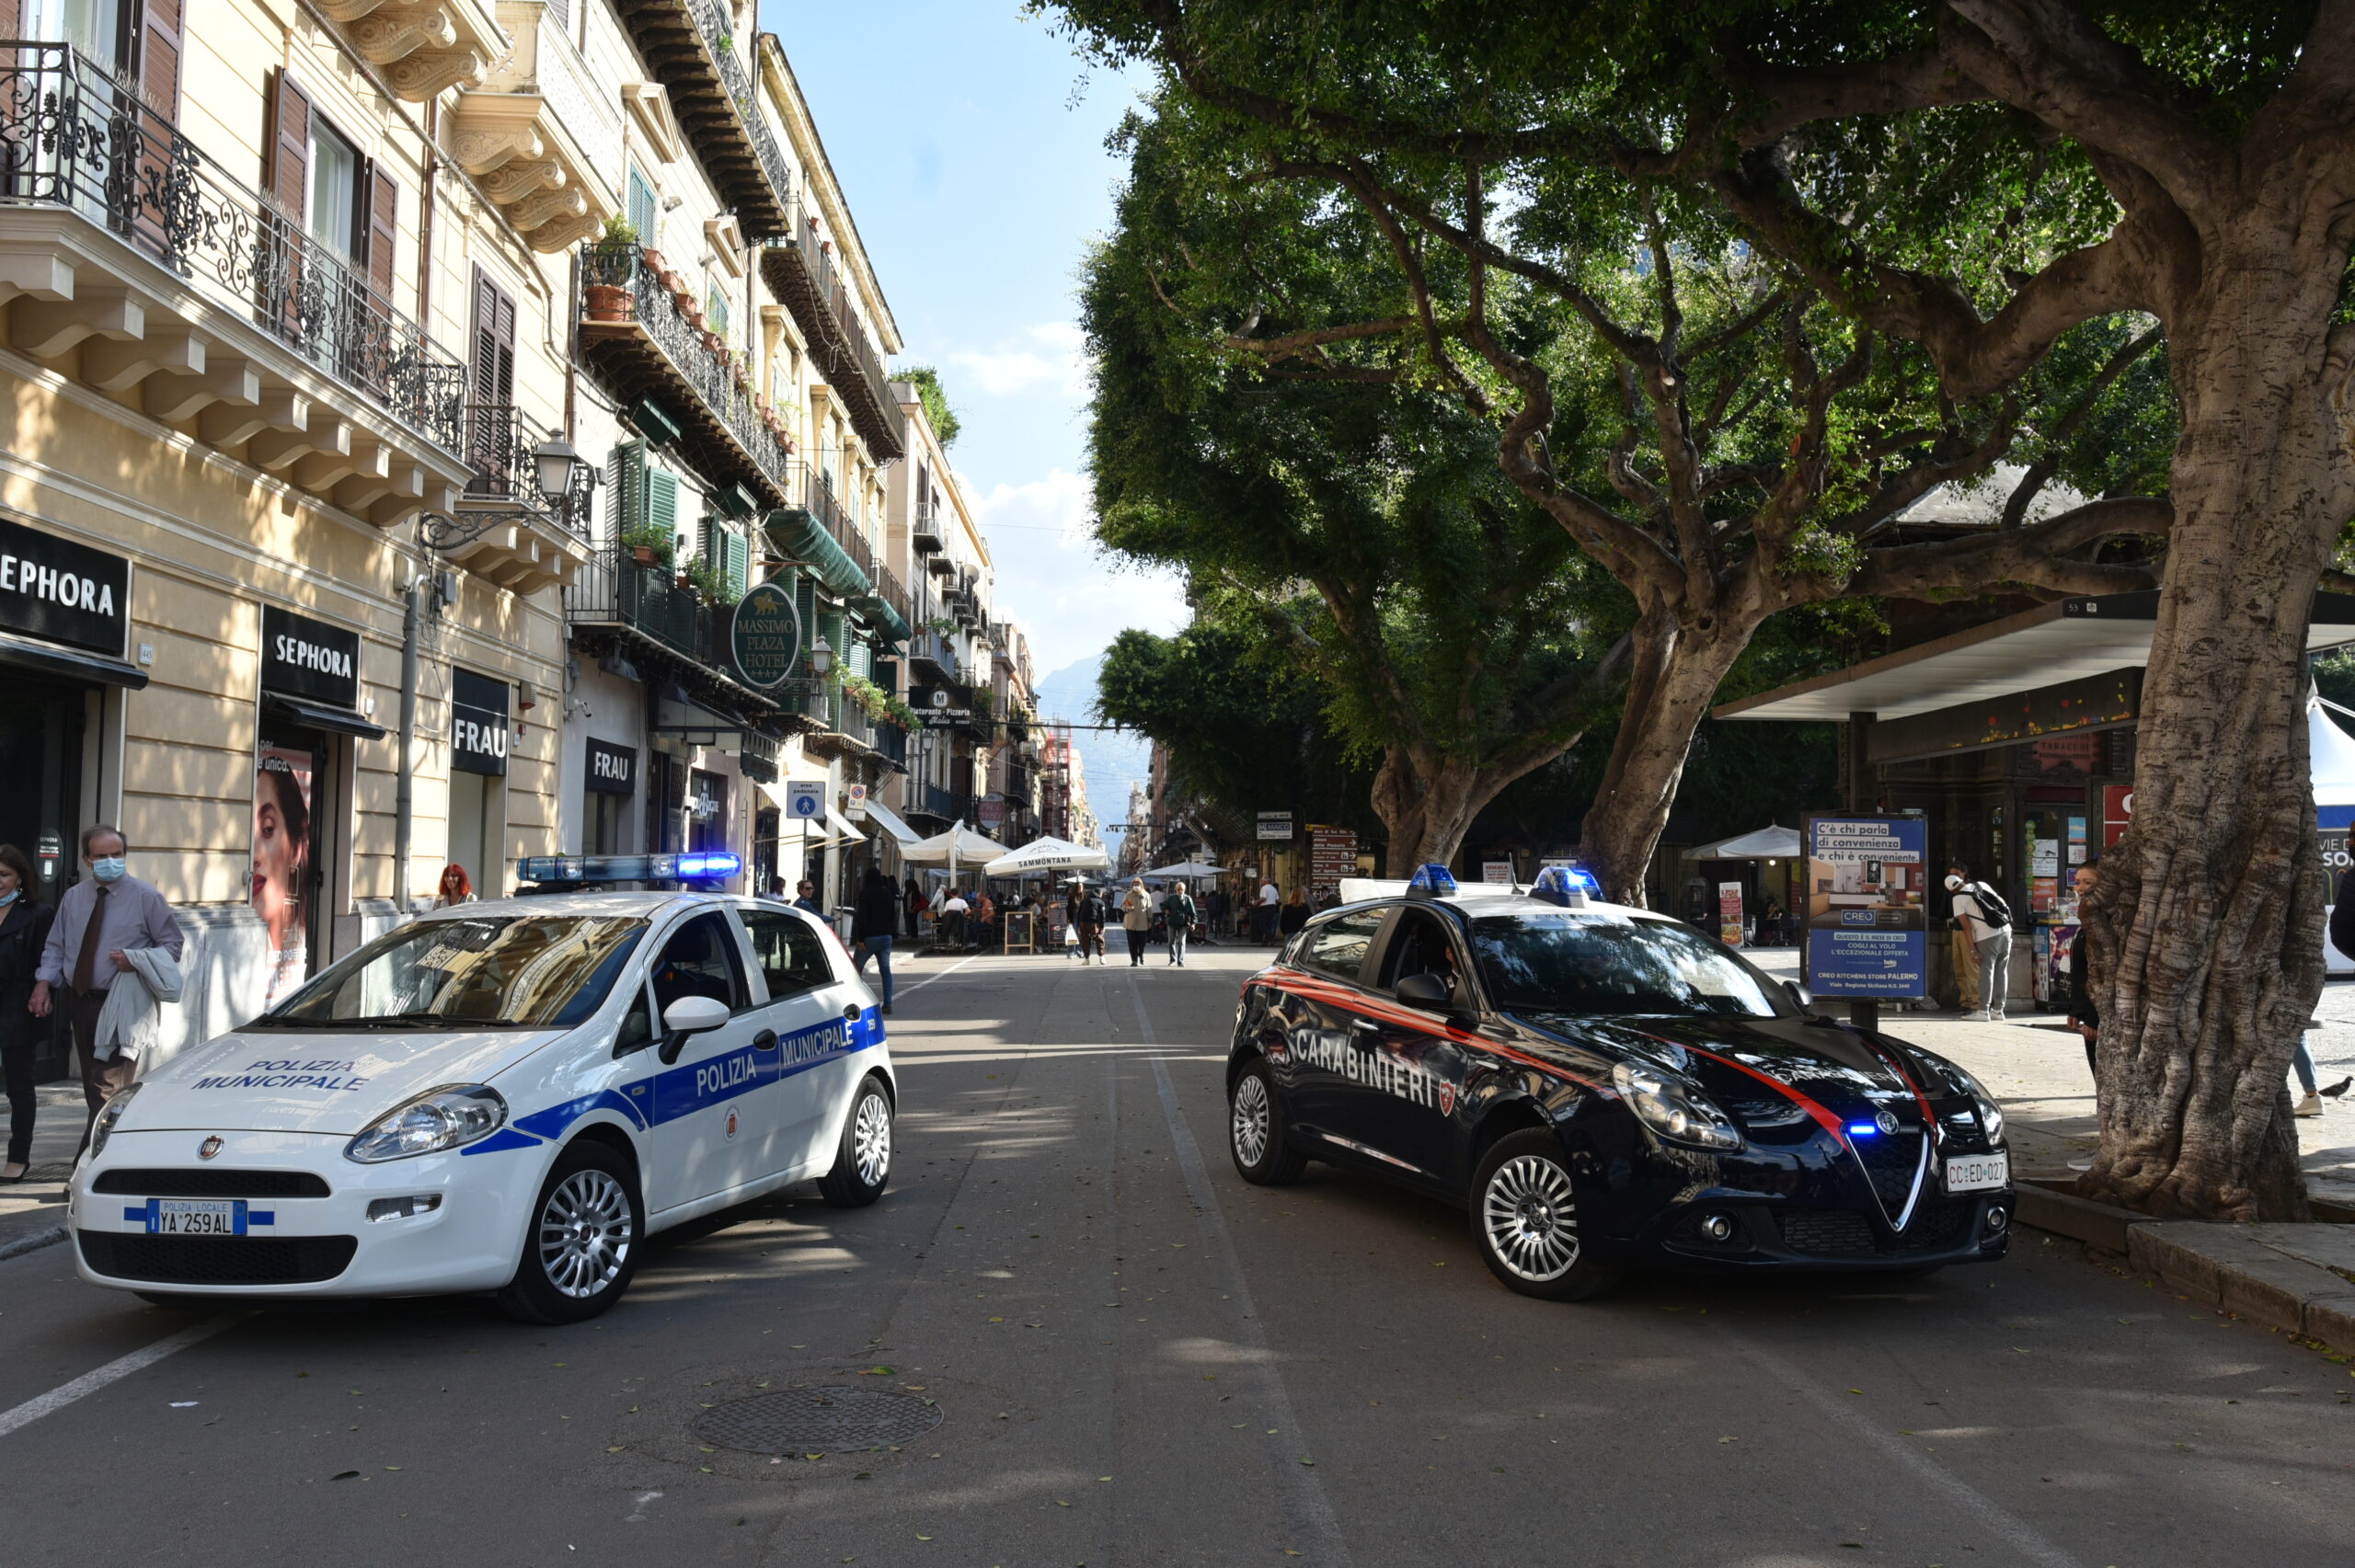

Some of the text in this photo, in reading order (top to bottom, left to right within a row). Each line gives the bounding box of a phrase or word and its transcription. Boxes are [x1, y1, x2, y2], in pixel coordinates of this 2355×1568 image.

[0, 555, 114, 617] EPHORA
[738, 620, 794, 633] MASSIMO
[747, 636, 785, 650] PLAZA
[276, 635, 351, 679] SEPHORA
[744, 654, 787, 668] HOTEL
[947, 708, 971, 716] Pizzeria
[454, 718, 507, 758] FRAU
[593, 751, 628, 782] FRAU
[1818, 824, 1888, 836] C'è chi parla
[1818, 837, 1899, 848] di convenienza
[1017, 856, 1072, 867] SAMMONTANA
[1818, 851, 1918, 863] e chi è conveniente.
[1844, 912, 1873, 921] CREO
[696, 1021, 854, 1096] POLIZIA MUNICIPALE
[245, 1060, 355, 1072] POLIZIA
[1297, 1029, 1432, 1108] CARABINIERI
[191, 1075, 370, 1092] MUNICIPALE
[1949, 1162, 2005, 1184] CC ED 027
[164, 1202, 228, 1213] POLIZIA LOCALE
[160, 1212, 177, 1232] YA
